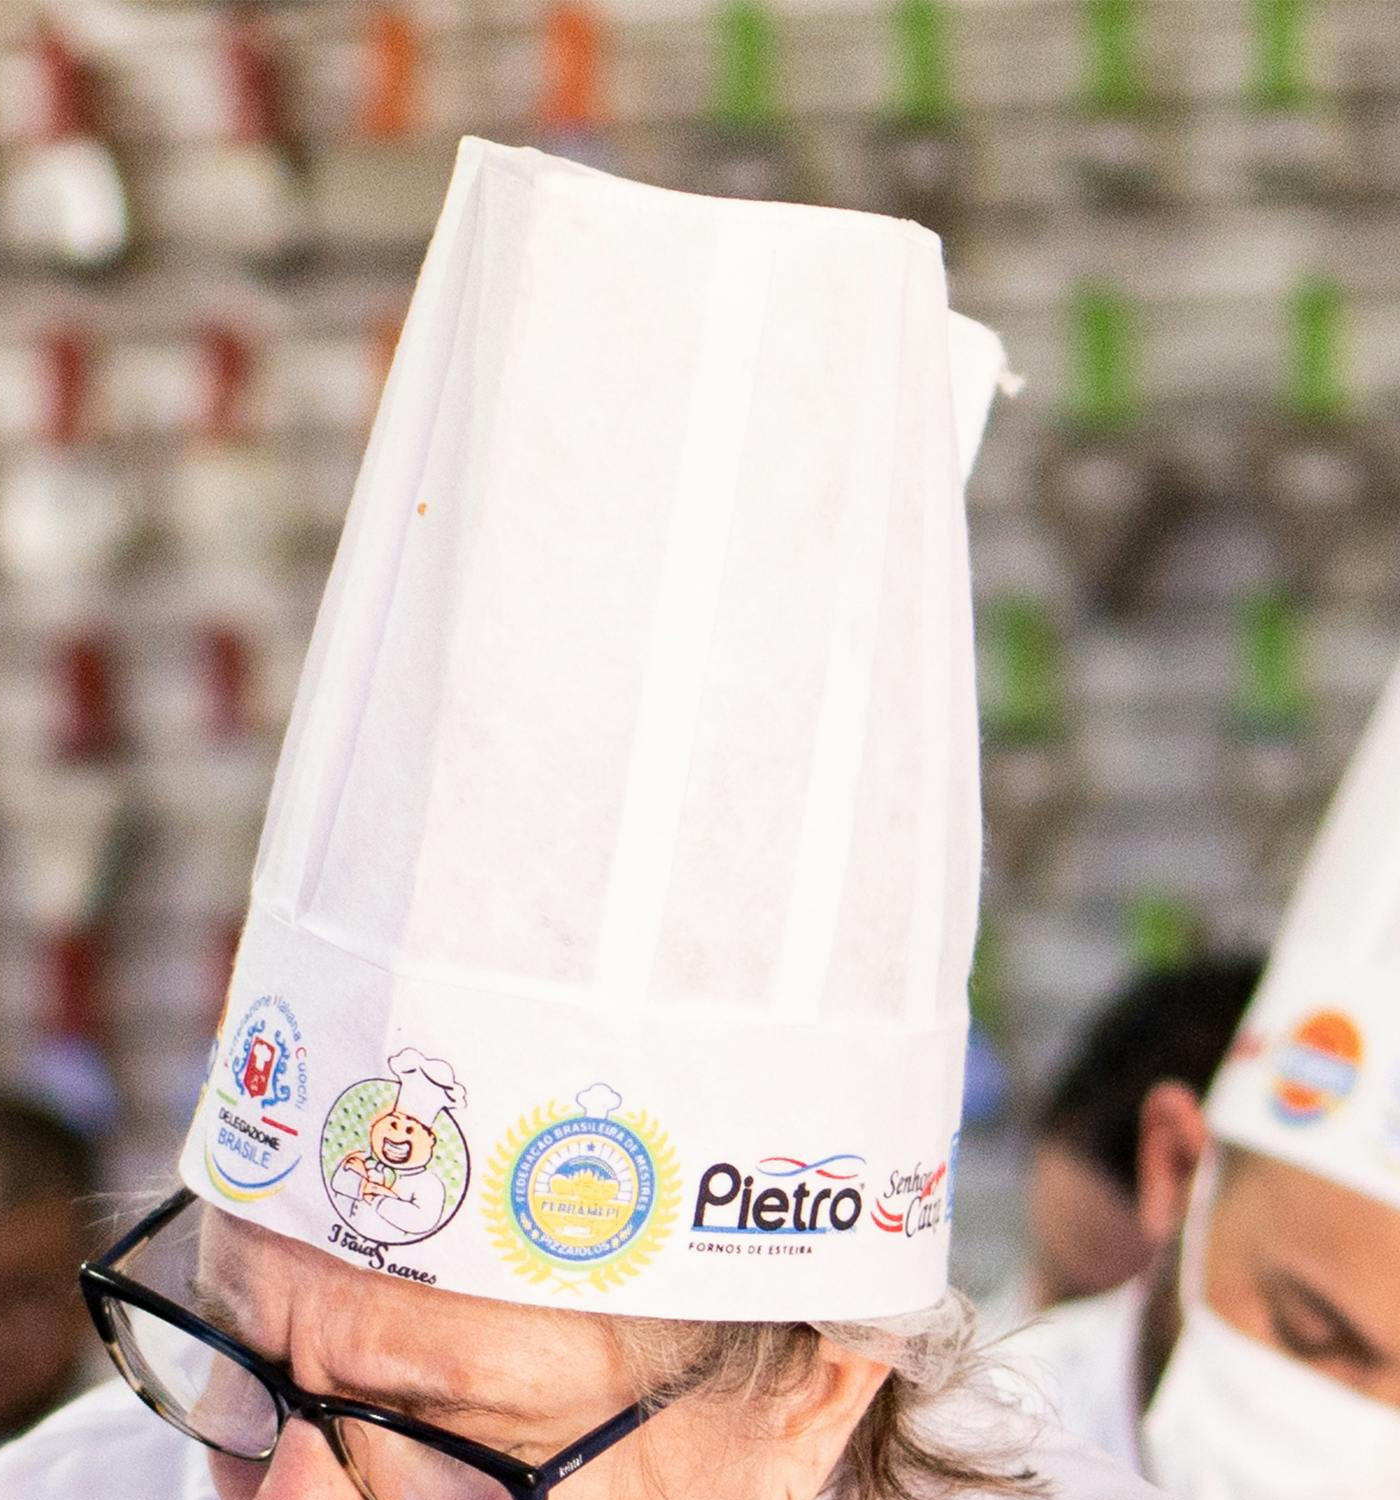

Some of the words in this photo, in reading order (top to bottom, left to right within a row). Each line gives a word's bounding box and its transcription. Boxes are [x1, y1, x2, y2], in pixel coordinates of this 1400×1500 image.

[217, 1127, 272, 1170] BRASILE
[694, 1163, 862, 1231] Pietro
[688, 1242, 741, 1255] FORNOS
[747, 1245, 762, 1255] DE
[768, 1245, 813, 1255] ESTEIRA
